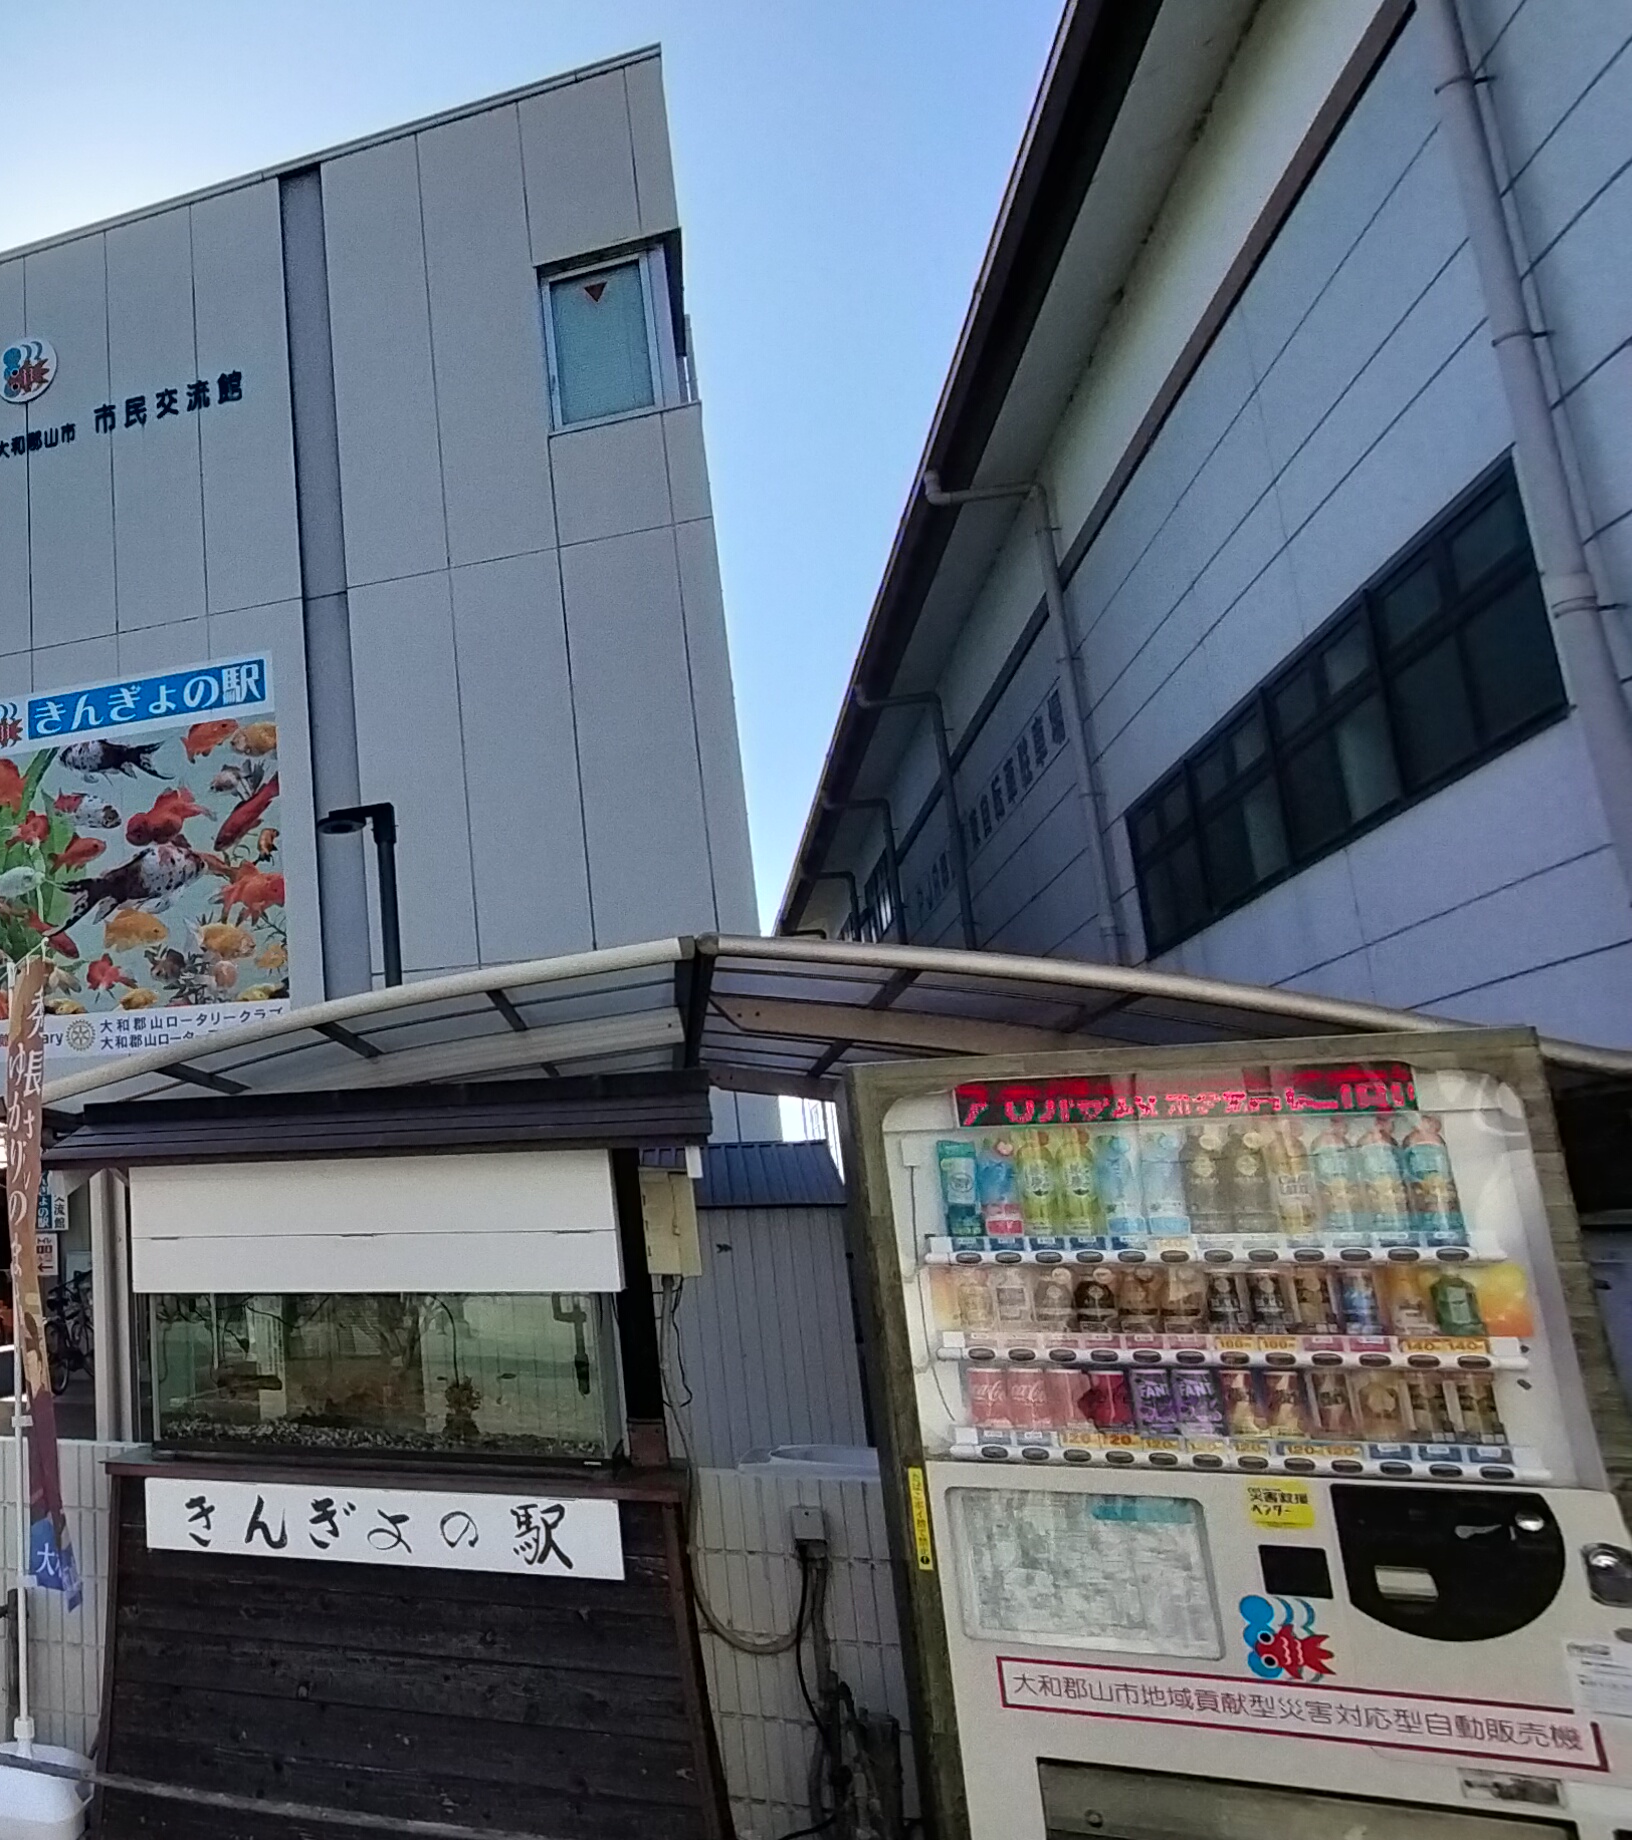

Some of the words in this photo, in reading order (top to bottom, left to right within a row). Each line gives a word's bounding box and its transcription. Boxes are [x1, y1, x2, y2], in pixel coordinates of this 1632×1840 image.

[94, 370, 243, 434] 市民交流館
[1013, 1672, 1584, 1751] 大和郡山市地域貢献型災害対応型自動販売機
